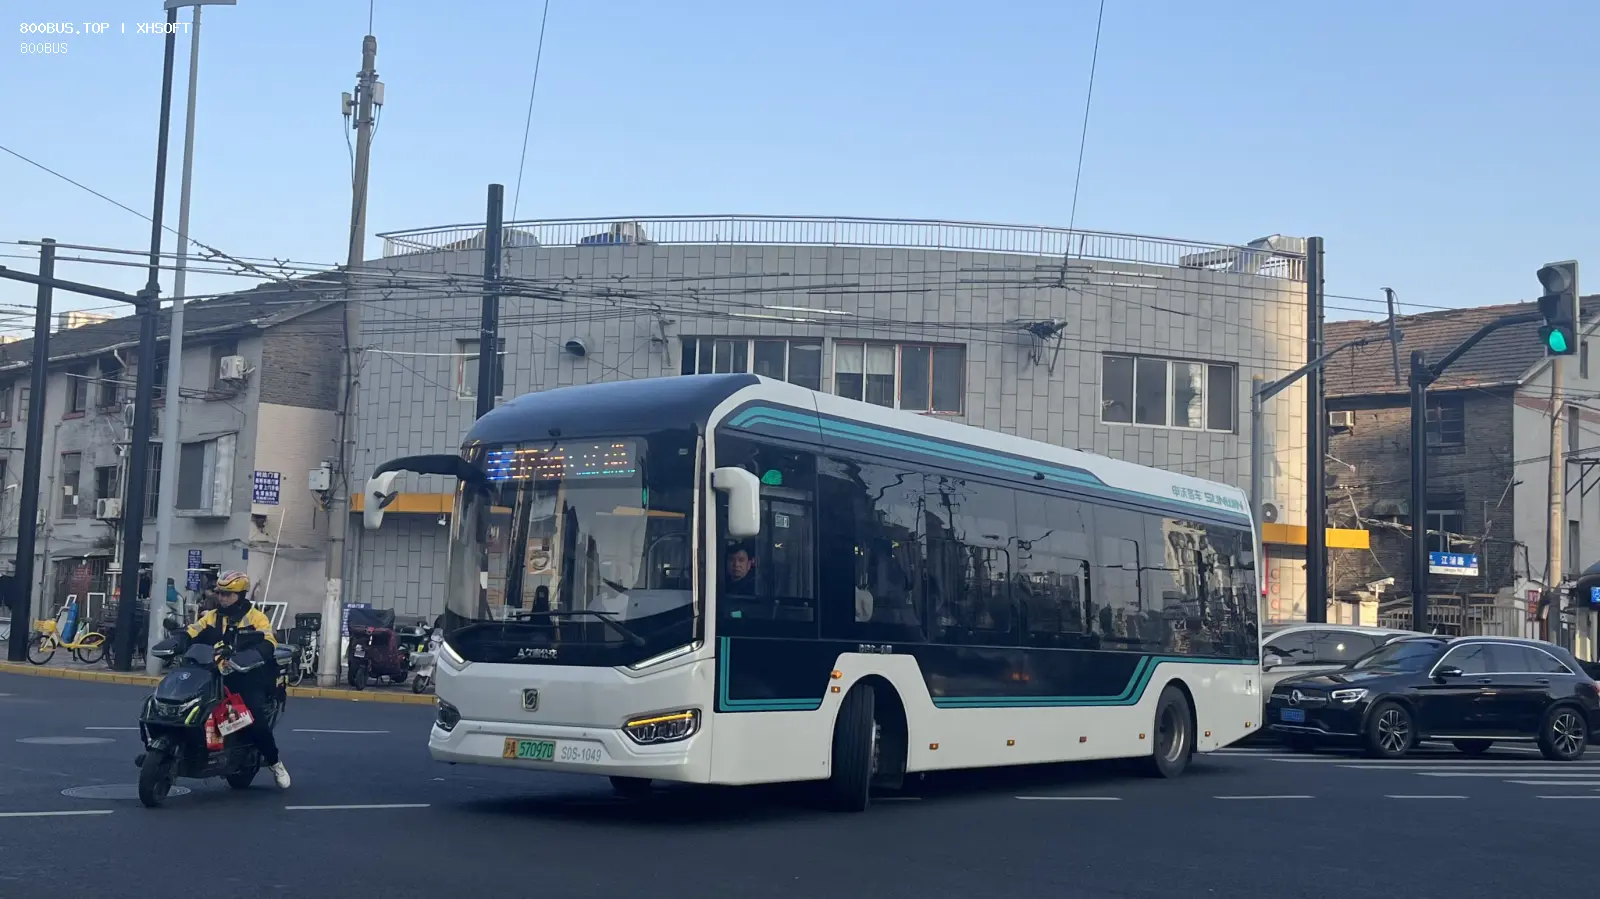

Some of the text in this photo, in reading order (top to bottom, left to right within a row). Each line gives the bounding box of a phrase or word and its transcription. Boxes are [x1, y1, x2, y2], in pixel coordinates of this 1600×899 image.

[1172, 485, 1244, 510] 申沃客车 SUNWIN
